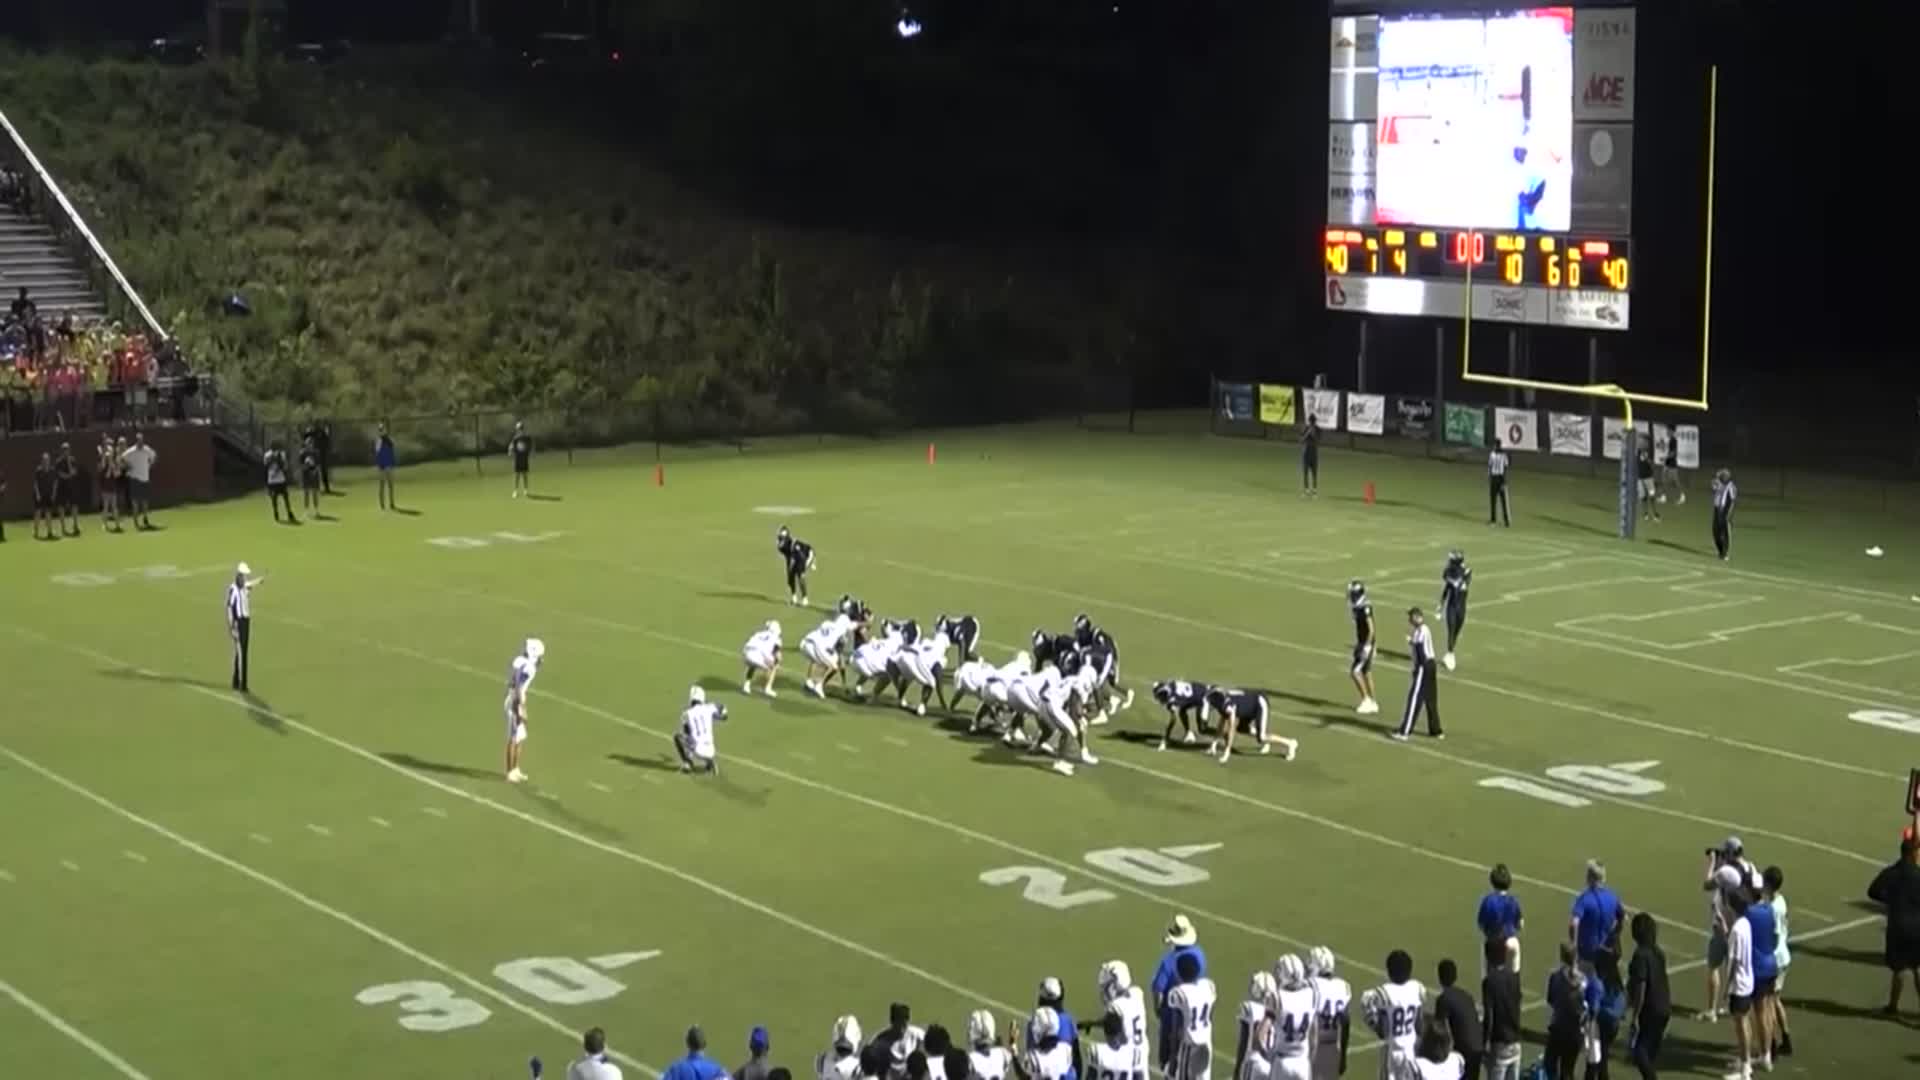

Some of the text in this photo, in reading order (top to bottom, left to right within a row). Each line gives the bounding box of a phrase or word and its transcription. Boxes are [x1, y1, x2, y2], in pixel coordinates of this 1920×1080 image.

[1584, 72, 1625, 106] ACE
[1326, 245, 1348, 274] 40
[1394, 250, 1406, 275] 4
[1505, 253, 1523, 284] 10
[1548, 255, 1560, 286] 6
[1568, 262, 1580, 287] 0
[1603, 258, 1627, 290] 40
[1478, 765, 1665, 807] 10
[979, 847, 1210, 909] 20
[354, 956, 628, 1032] 30
[1190, 1003, 1208, 1031] 14
[1283, 1012, 1309, 1043] 44
[1392, 1005, 1416, 1036] 82
